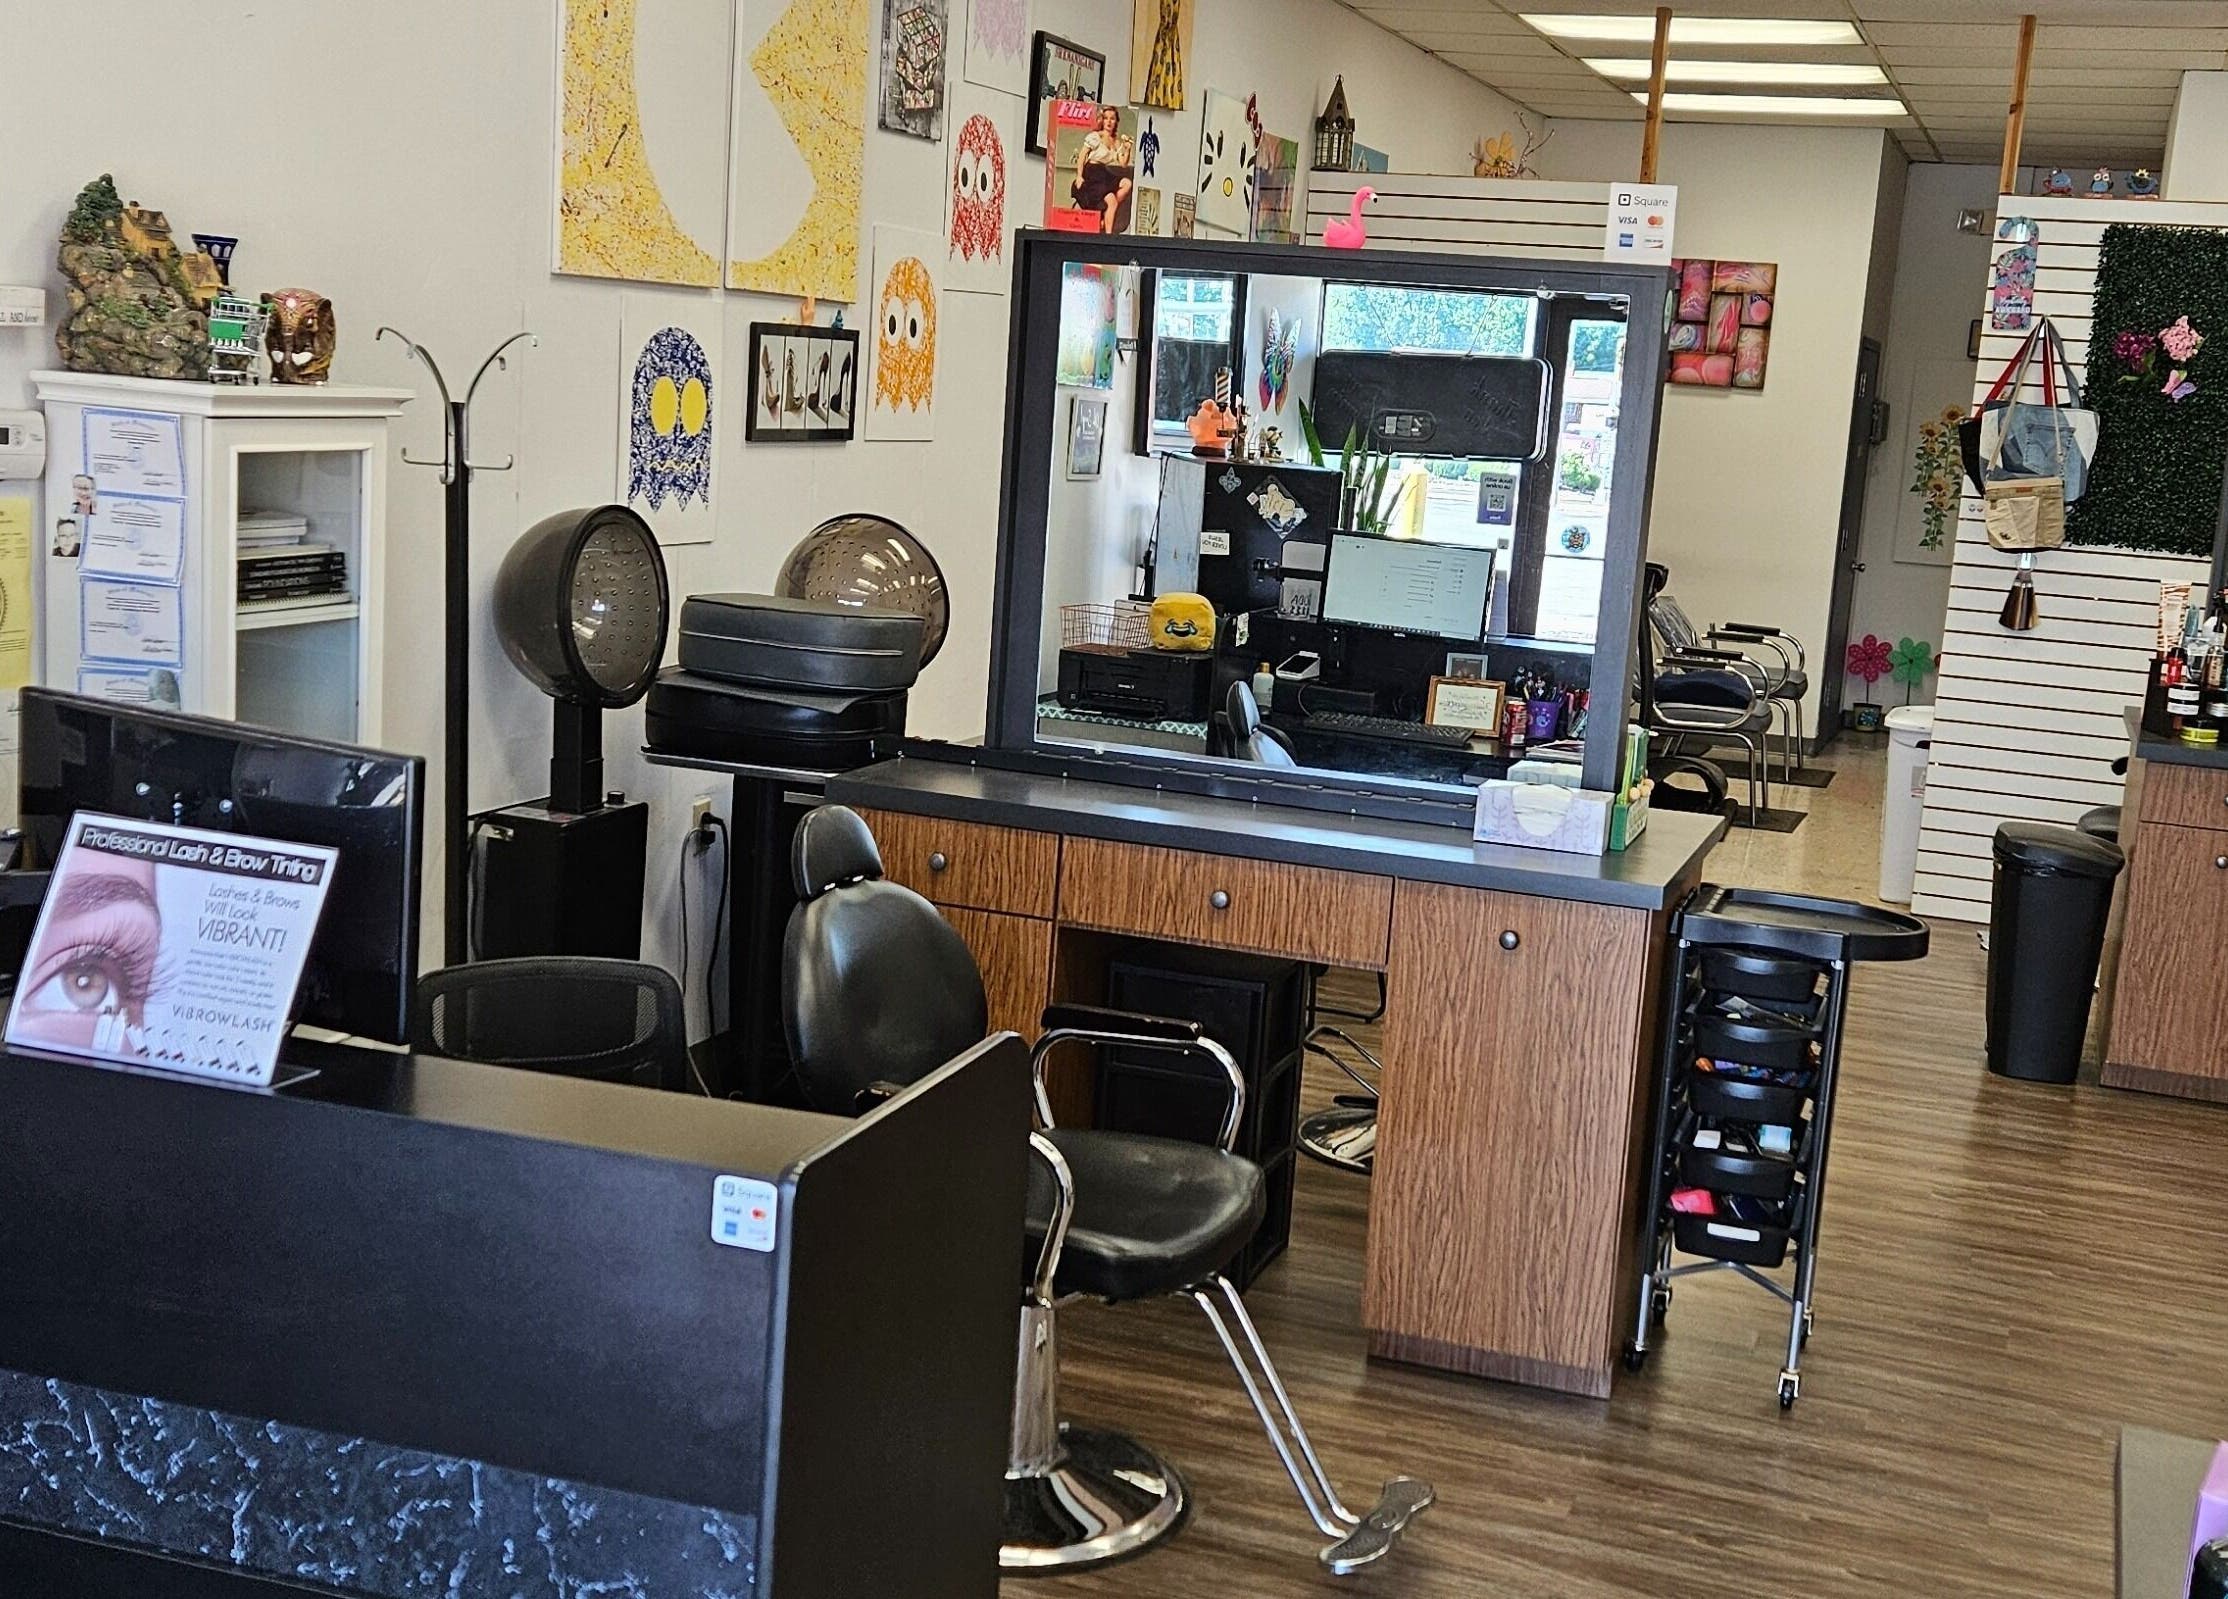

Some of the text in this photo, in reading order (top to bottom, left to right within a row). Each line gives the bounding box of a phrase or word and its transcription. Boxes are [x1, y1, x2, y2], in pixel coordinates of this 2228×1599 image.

[1058, 101, 1093, 120] Flirt
[1634, 195, 1669, 208] Square
[1618, 215, 1638, 225] VISA
[81, 827, 317, 882] Professional Lash & Brow Tinting
[208, 882, 301, 911] Lashes & Brows
[205, 900, 259, 921] Will Look
[198, 917, 288, 953] VIBRANT!
